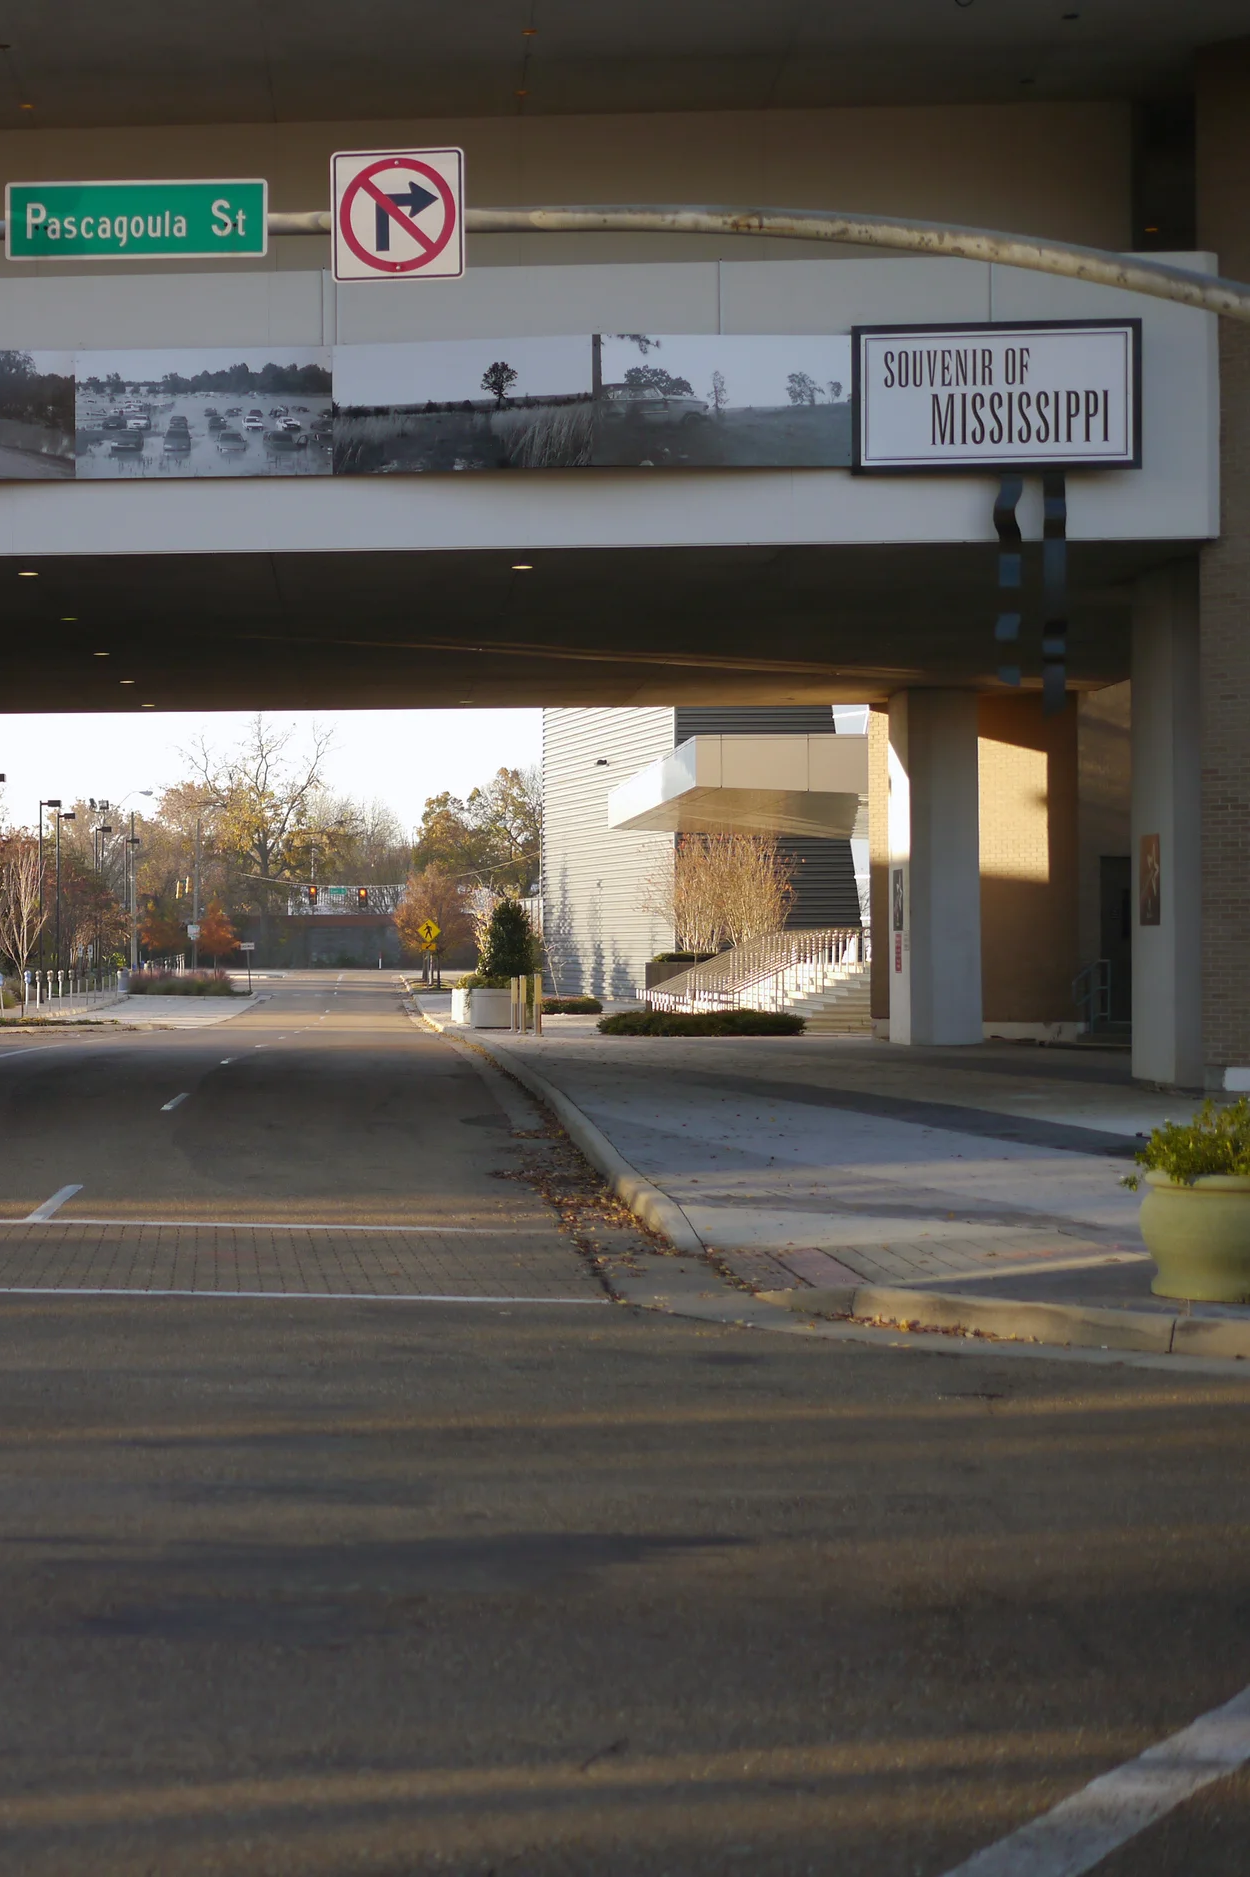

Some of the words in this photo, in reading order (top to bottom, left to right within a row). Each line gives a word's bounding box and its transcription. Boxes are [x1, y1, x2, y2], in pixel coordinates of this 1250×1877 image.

[26, 203, 187, 247] Pascagoula
[211, 199, 246, 237] St
[883, 348, 993, 388] SOUVENIR
[1004, 347, 1030, 386] OF
[931, 389, 1110, 446] MISSISSIPPI
